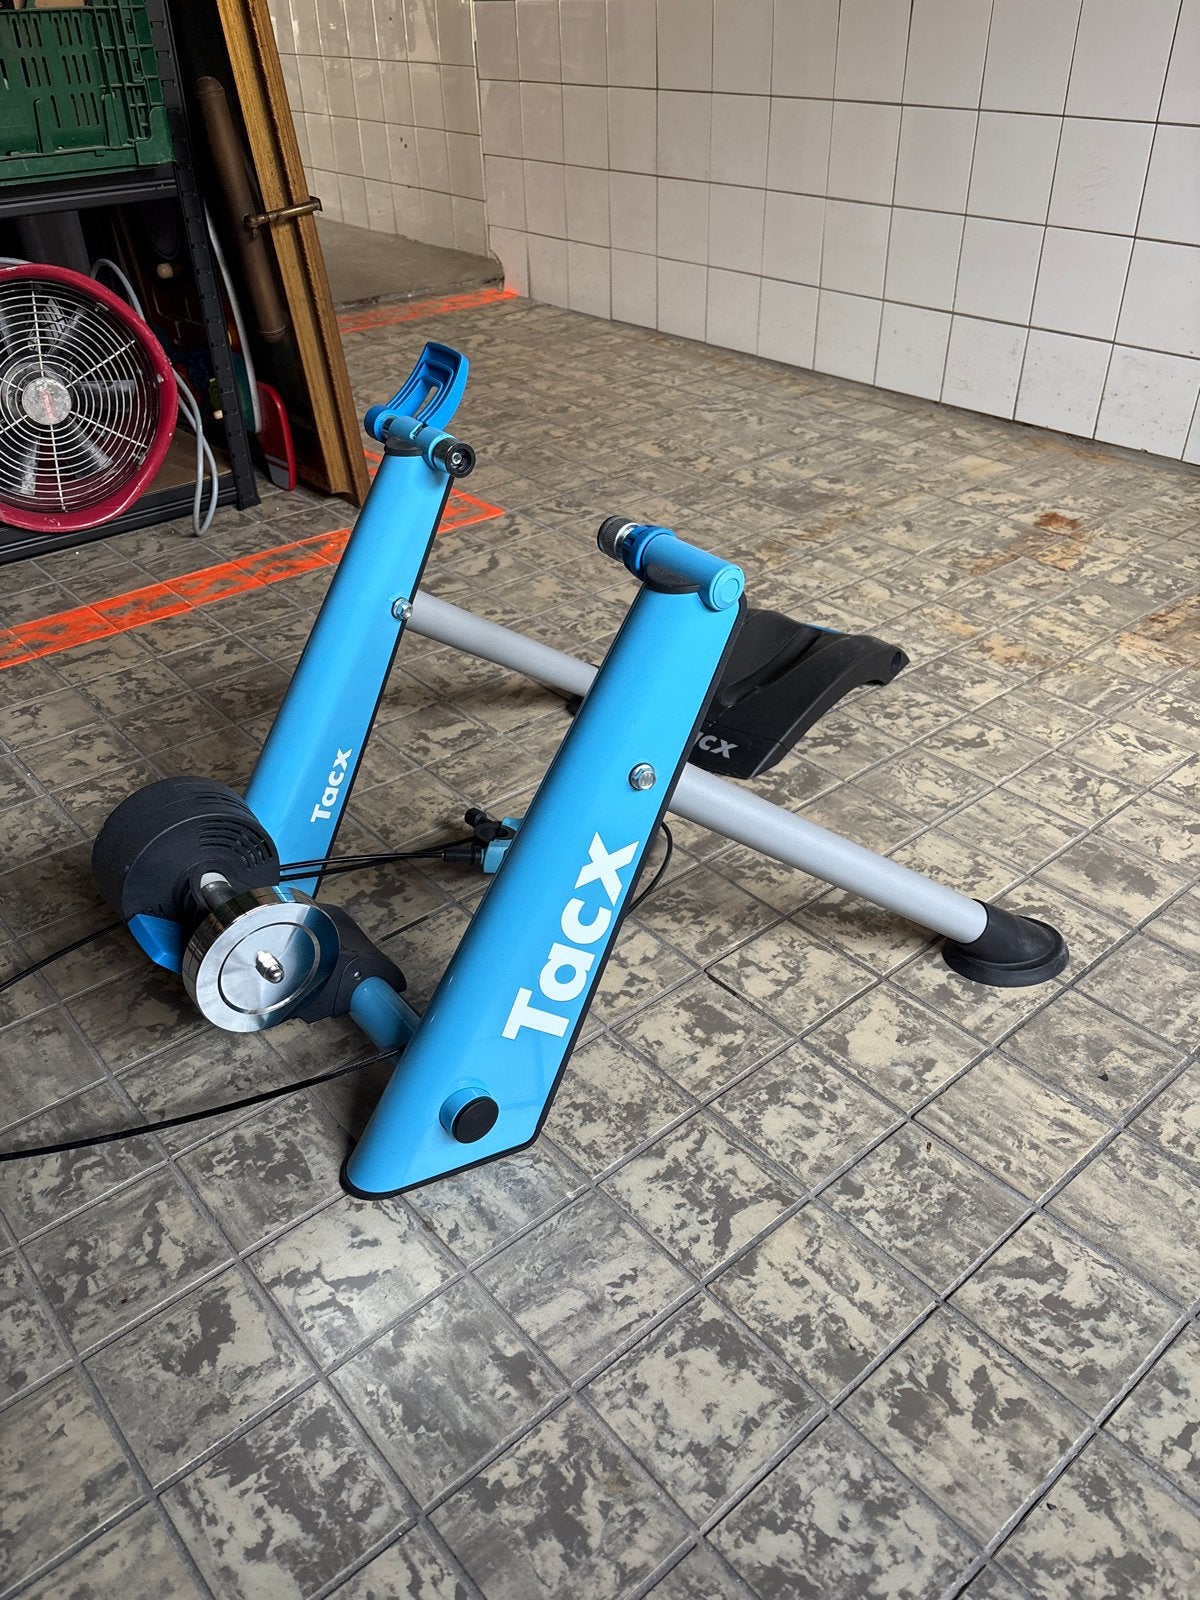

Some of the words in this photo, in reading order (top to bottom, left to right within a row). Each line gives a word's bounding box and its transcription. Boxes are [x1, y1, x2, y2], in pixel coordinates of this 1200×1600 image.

[693, 731, 738, 759] cx
[310, 748, 352, 823] Tacx
[501, 831, 640, 1040] Tacx
